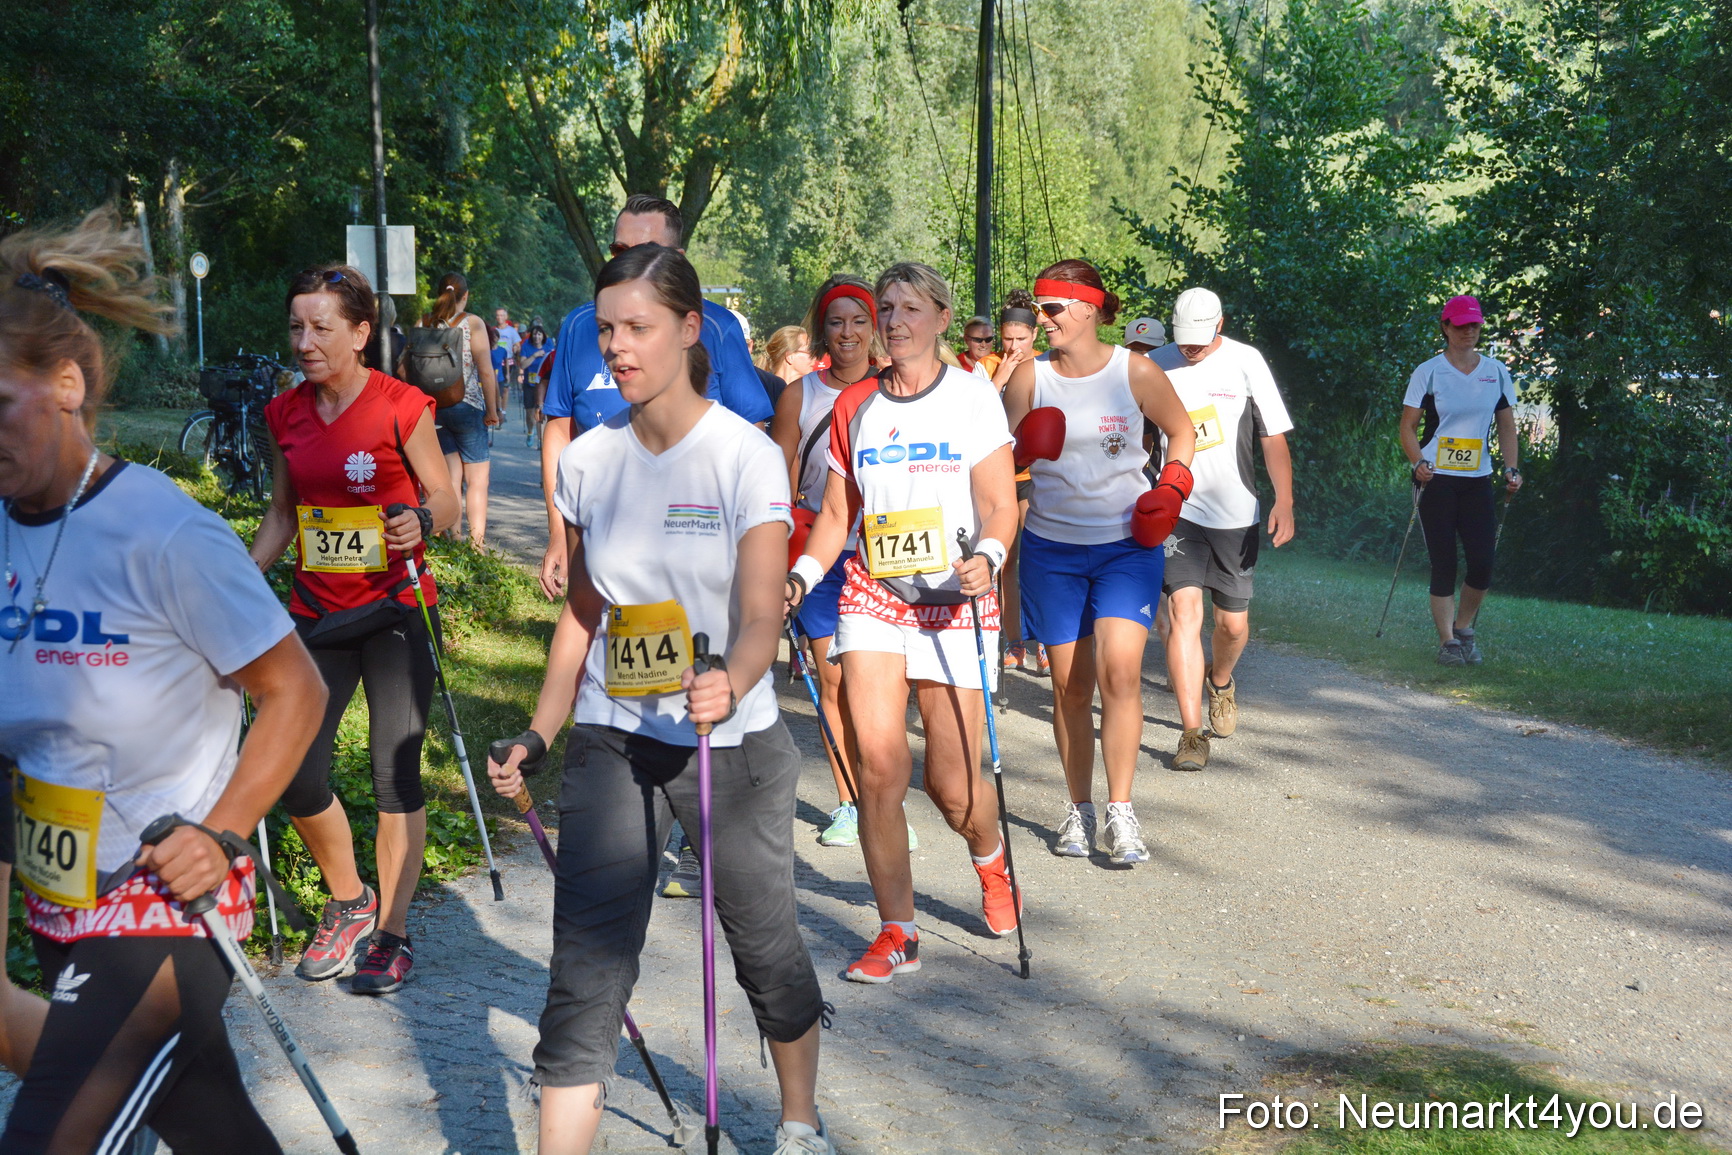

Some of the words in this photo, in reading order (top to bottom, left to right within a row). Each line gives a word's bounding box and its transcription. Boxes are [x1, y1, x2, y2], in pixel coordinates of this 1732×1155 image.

[1101, 416, 1128, 424] TRENDHAUS
[1098, 424, 1117, 433] POWER
[1118, 424, 1130, 432] TEAM
[1447, 448, 1473, 461] 762
[908, 461, 961, 474] energie
[346, 484, 376, 494] caritas
[663, 519, 721, 531] NeuerMarkt
[316, 530, 365, 554] 374
[875, 530, 931, 559] 1741
[906, 555, 935, 564] Manuela
[902, 605, 954, 622] AVIA
[35, 641, 130, 667] energie
[611, 633, 679, 670] 1414
[637, 669, 668, 679] Nadine
[16, 809, 77, 872] 1740
